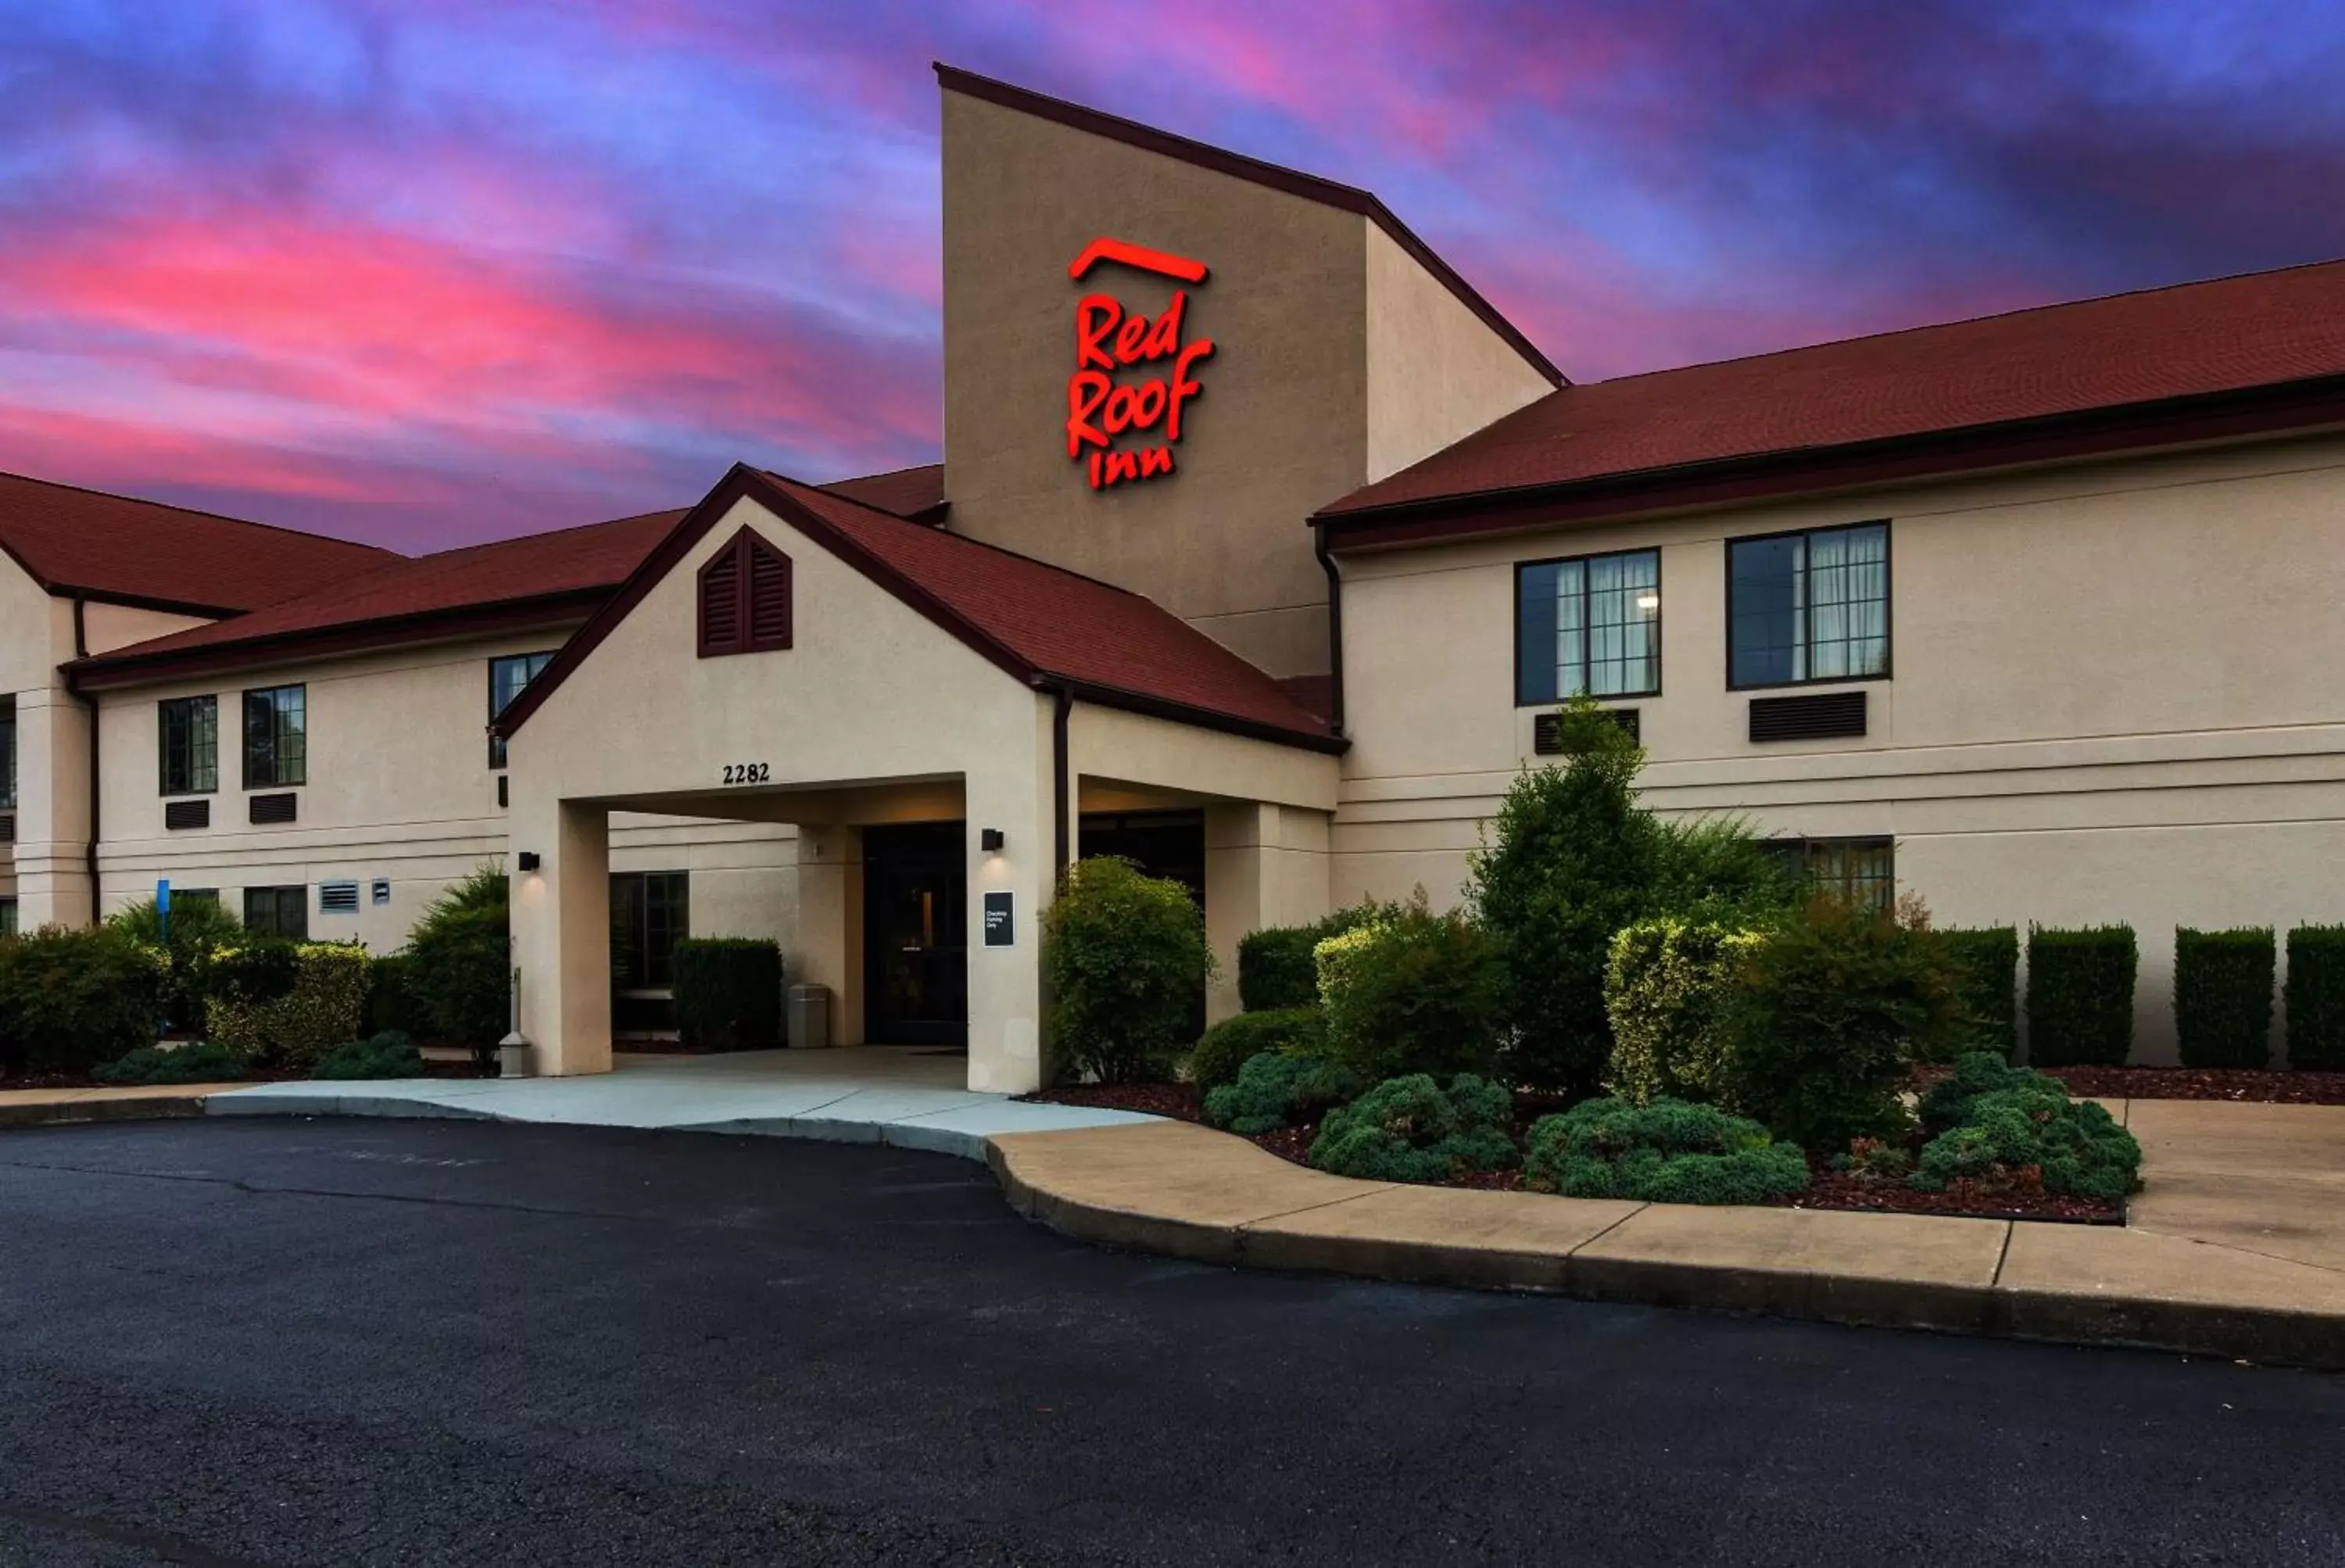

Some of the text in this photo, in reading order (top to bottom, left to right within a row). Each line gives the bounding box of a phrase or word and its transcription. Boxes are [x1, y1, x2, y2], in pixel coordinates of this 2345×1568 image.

[1077, 289, 1184, 369] Red
[1067, 338, 1212, 456] Roof
[723, 762, 770, 785] 2282
